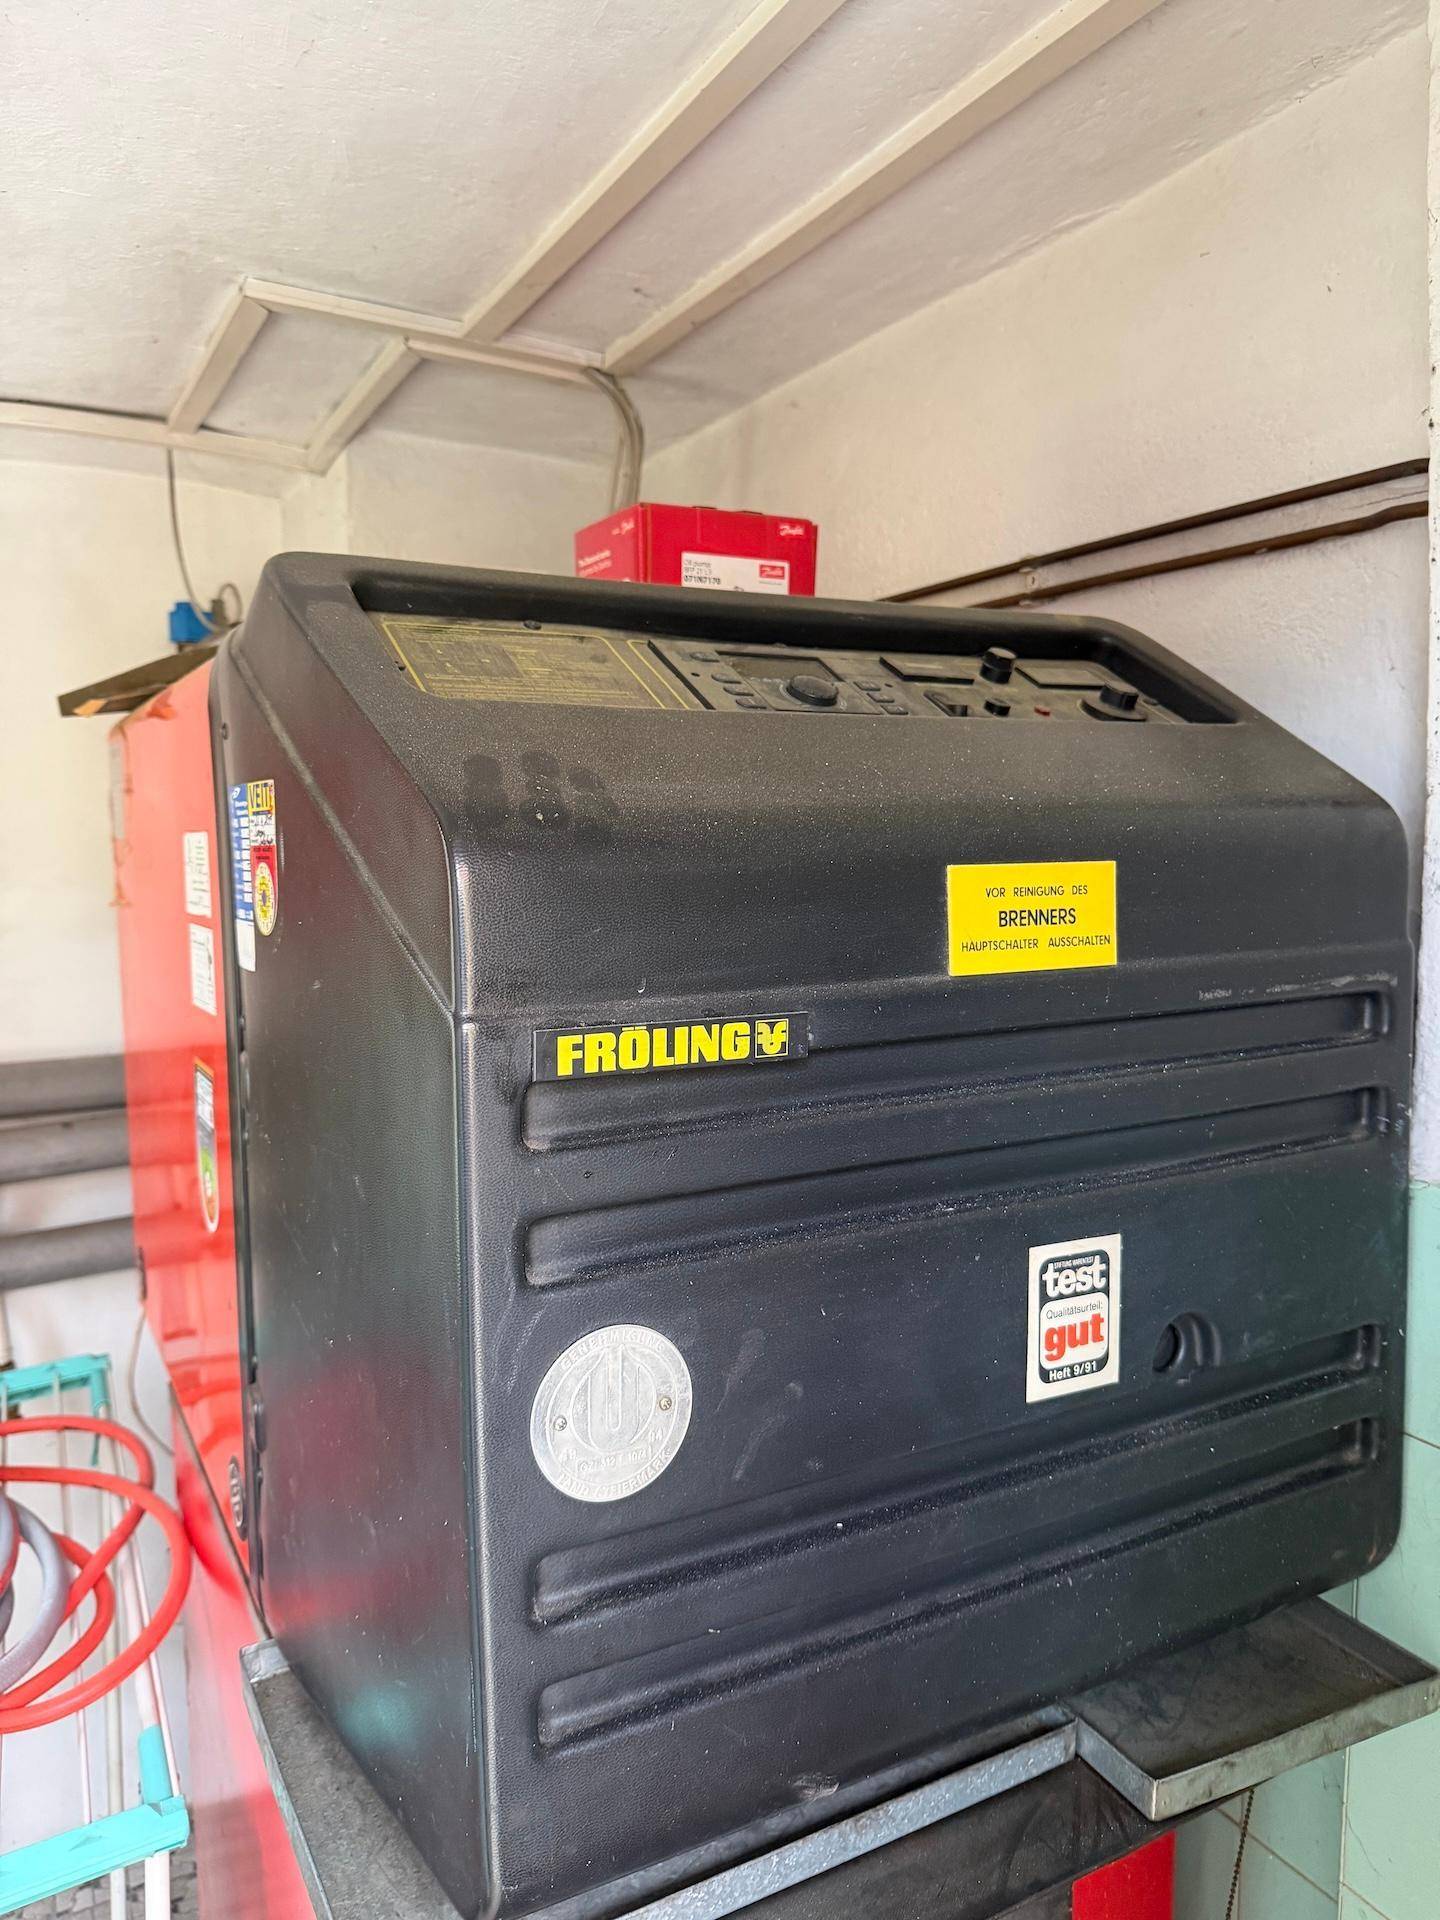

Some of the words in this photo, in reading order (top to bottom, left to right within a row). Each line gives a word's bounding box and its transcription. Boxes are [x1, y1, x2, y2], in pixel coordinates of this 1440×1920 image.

[985, 887, 1006, 898] VOR
[1013, 885, 1065, 897] REINIGUNG
[1071, 884, 1088, 896] DES
[998, 907, 1077, 928] BRENNERS
[961, 938, 1039, 952] HAUPTSCHALTER
[1047, 934, 1111, 948] AUSSCHALTEN
[557, 1021, 751, 1077] FRÖLING
[1041, 1255, 1107, 1298] test
[1044, 1312, 1105, 1362] gut
[1049, 1367, 1071, 1382] Heft
[1073, 1360, 1097, 1376] 9/91
